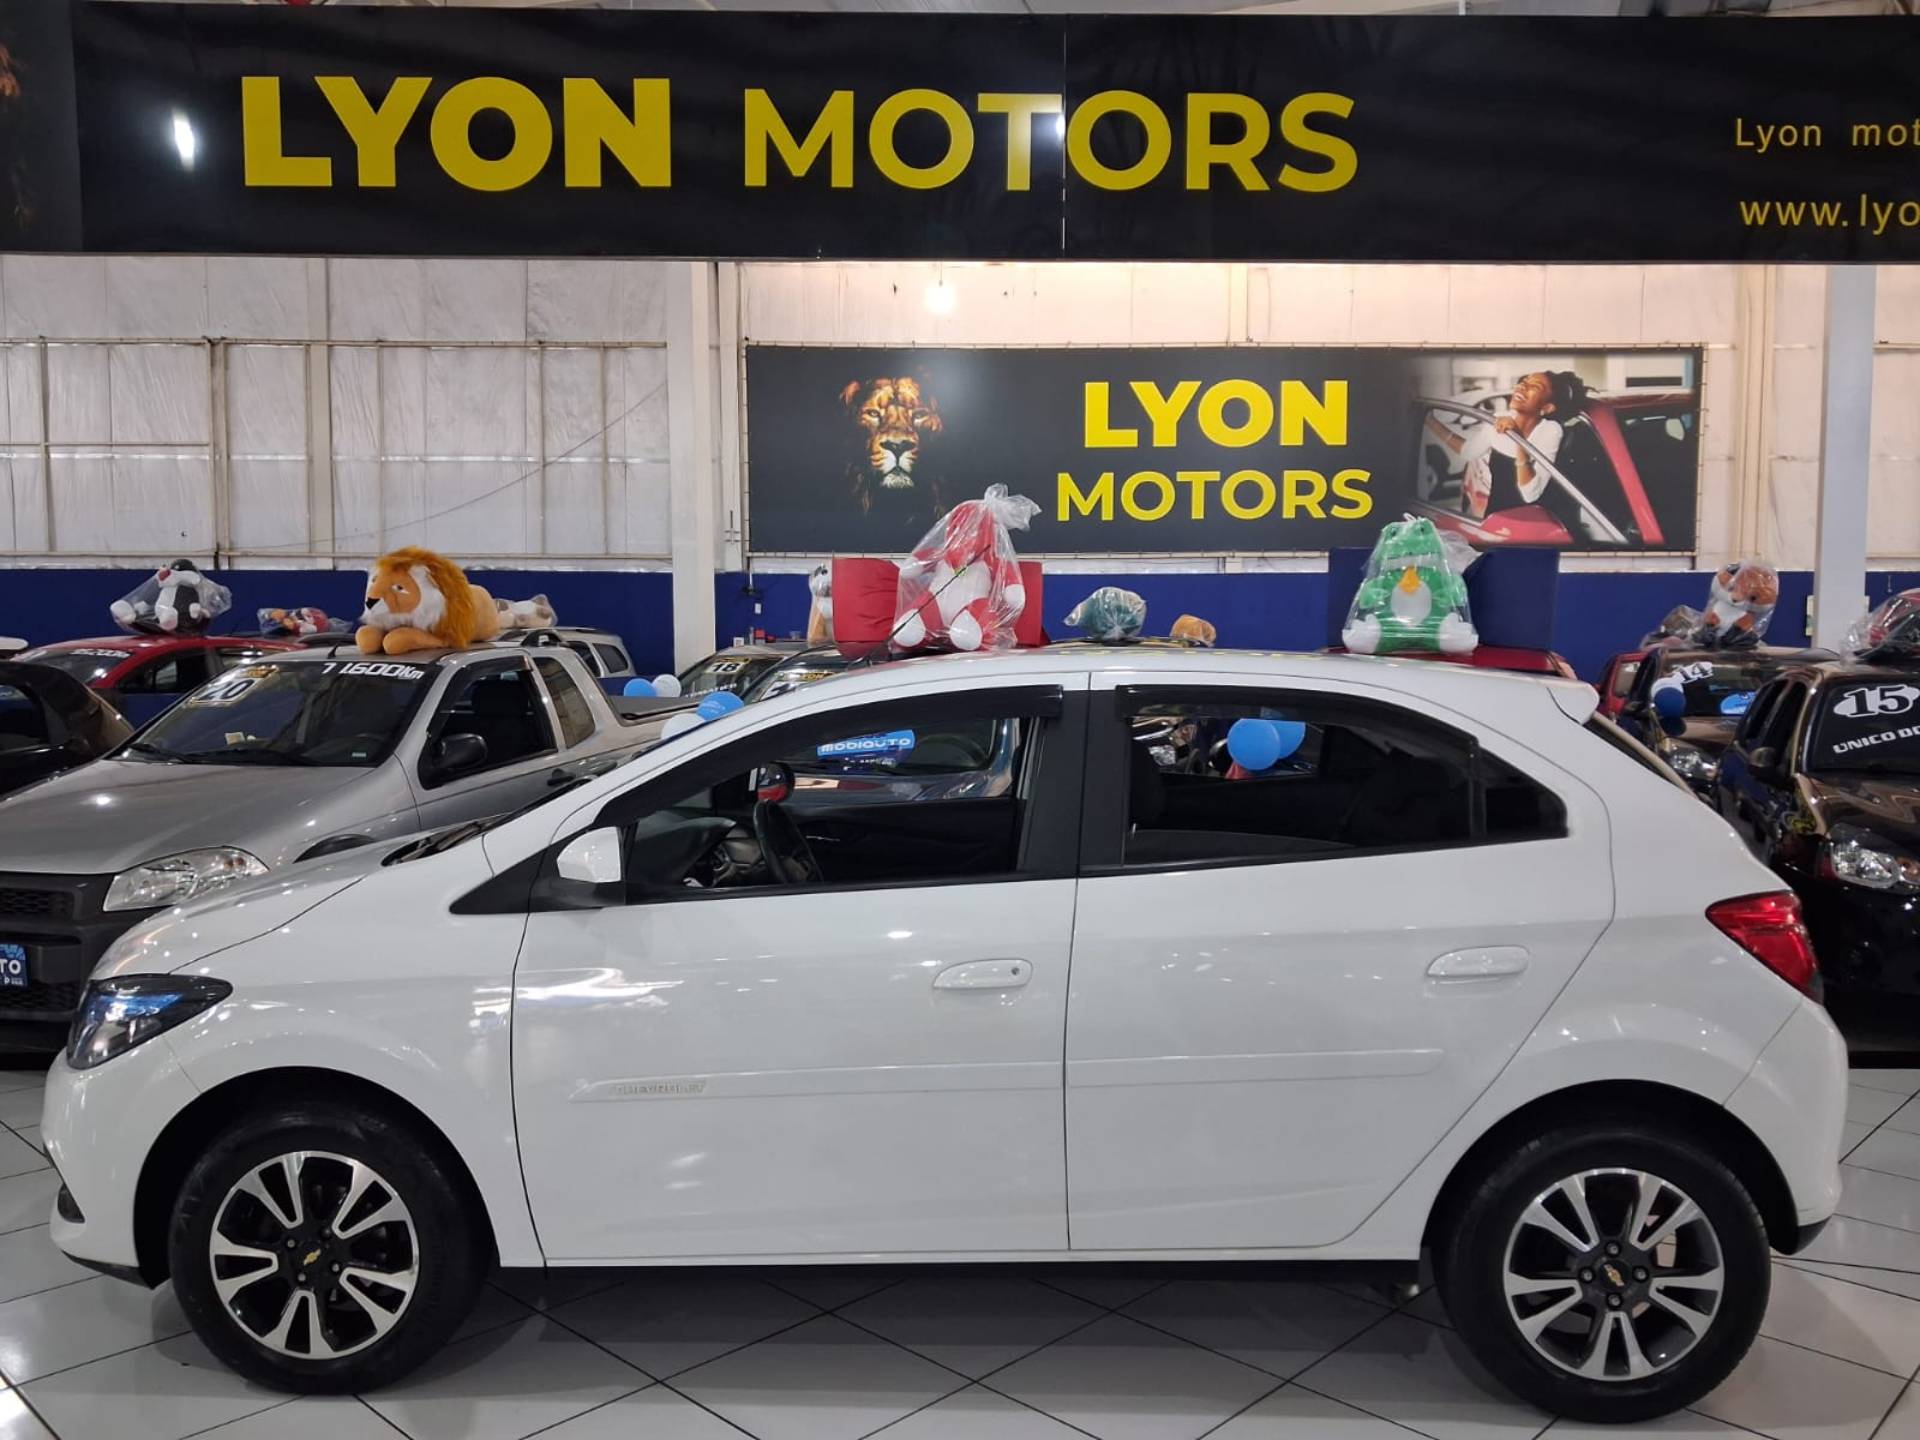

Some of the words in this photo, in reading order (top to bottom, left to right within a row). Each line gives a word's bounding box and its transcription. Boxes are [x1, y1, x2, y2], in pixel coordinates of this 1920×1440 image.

[242, 76, 672, 192] LYON
[744, 88, 1358, 194] MOTORS
[1735, 118, 1822, 153] Lyon
[1083, 379, 1350, 449] LYON
[1056, 468, 1374, 523] MOTORS
[1843, 684, 1914, 717] 15
[1833, 731, 1897, 754] UNICO
